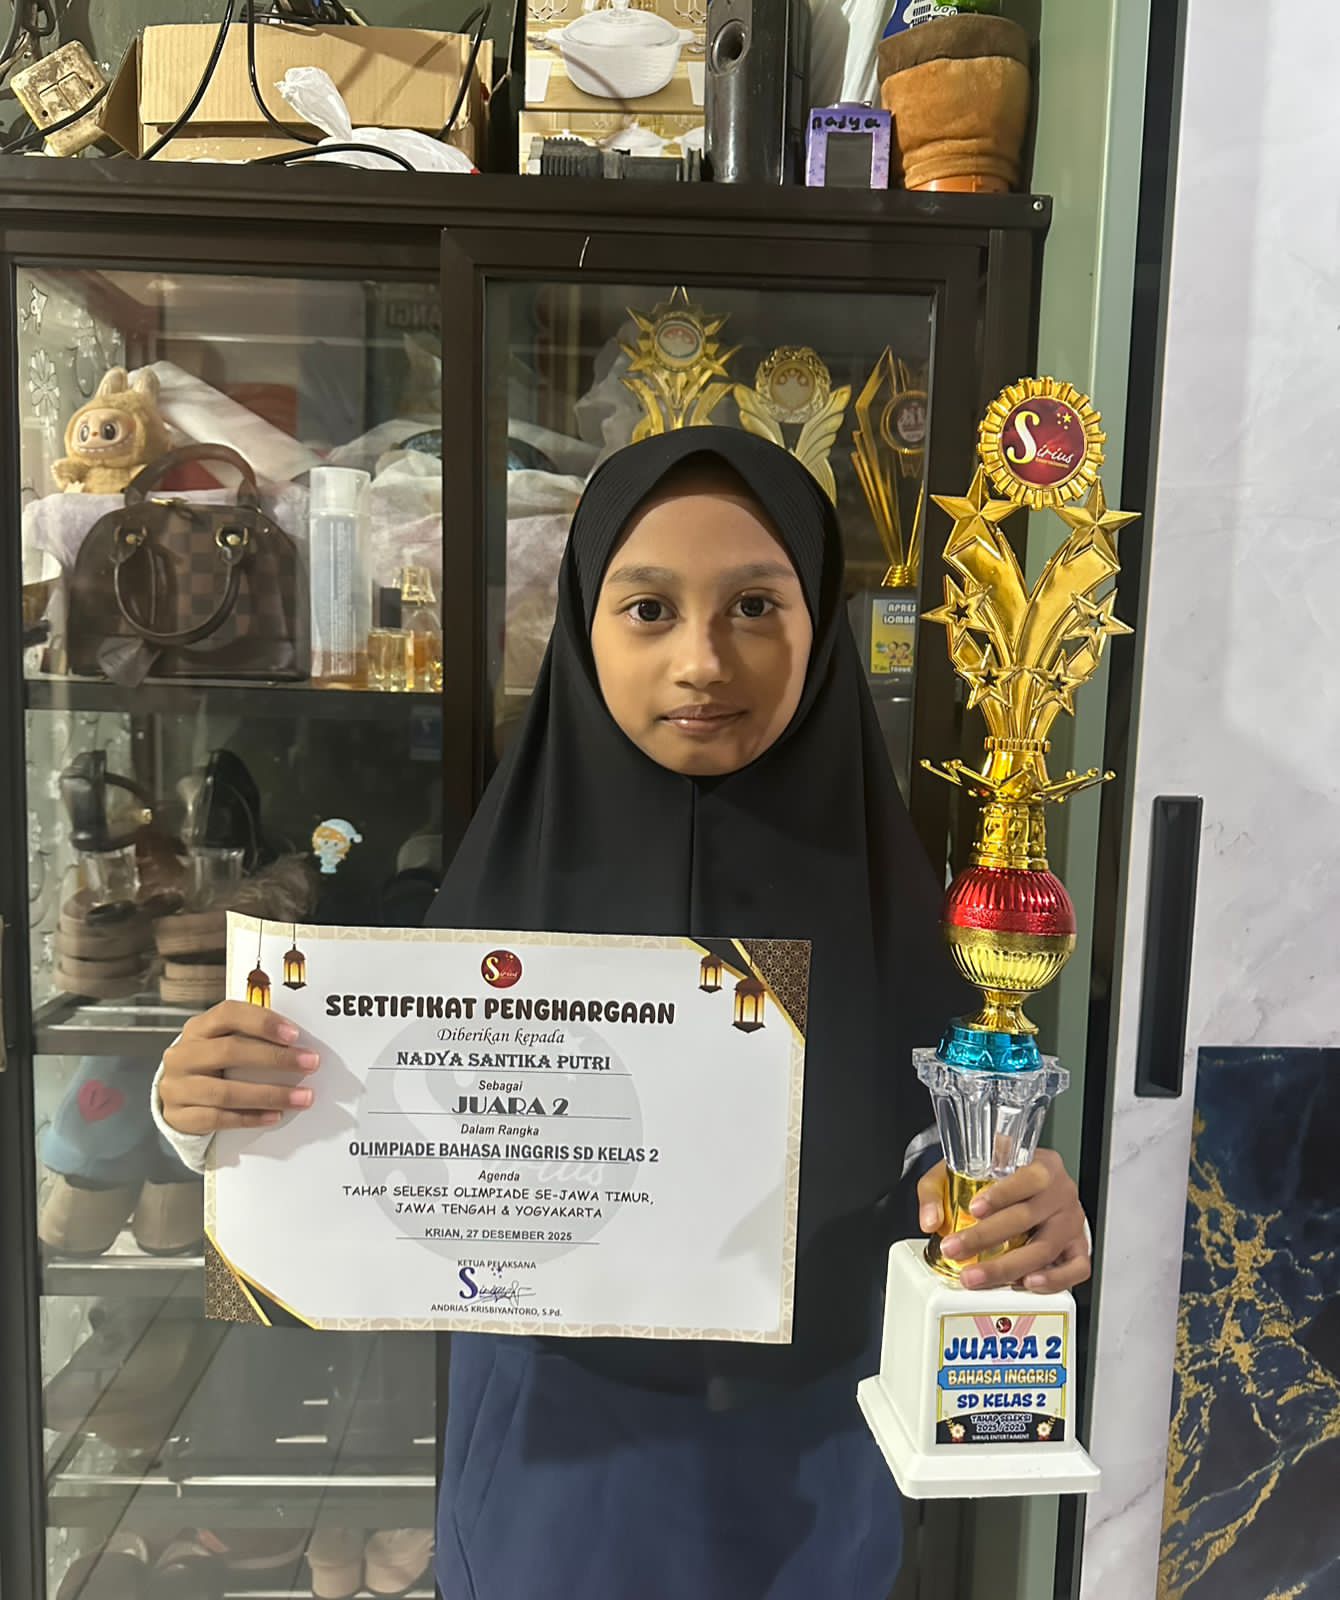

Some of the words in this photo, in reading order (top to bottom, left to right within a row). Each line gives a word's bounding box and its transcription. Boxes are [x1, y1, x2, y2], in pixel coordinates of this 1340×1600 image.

[812, 116, 881, 131] nadya
[1006, 410, 1074, 464] Sirius
[326, 994, 476, 1020] SERTIFIKAT
[485, 998, 675, 1025] PENGHARGAAN
[437, 1028, 510, 1046] Diberikan
[514, 1028, 565, 1047] kepada
[396, 1050, 463, 1067] NADYA
[468, 1053, 552, 1069] SANTIKA
[556, 1055, 611, 1071] PUTRI
[478, 1079, 523, 1094] Sebagai
[452, 1095, 546, 1116] JUARA
[552, 1098, 569, 1117] 2
[460, 1123, 495, 1136] Dalam
[498, 1125, 540, 1138] Rangka
[349, 1141, 436, 1158] OLIMPIADE
[439, 1143, 502, 1159] BAHASA
[505, 1144, 570, 1161] INGGRIS
[573, 1146, 594, 1161] SD
[597, 1147, 646, 1163] KELAS
[649, 1148, 659, 1163] 2
[478, 1170, 521, 1184] Agenda
[343, 1185, 389, 1198] TAHAP
[393, 1186, 449, 1199] SELEKSI
[453, 1187, 530, 1200] OLIMPIADE
[535, 1189, 600, 1202] SE-JAWA
[605, 1191, 654, 1205] TIMUR,
[395, 1203, 436, 1215] JAWA
[442, 1203, 497, 1216] TENGAH
[501, 1205, 510, 1217] &
[514, 1205, 603, 1219] YOGYAKARTA
[425, 1228, 463, 1239] KRIAN,
[466, 1228, 479, 1239] 27
[482, 1230, 545, 1241] DESEMBER
[547, 1231, 572, 1241] 2025
[458, 1259, 486, 1268] KETUA
[487, 1260, 537, 1270] PELAKSANA
[430, 1303, 469, 1313] ANDRIAS
[944, 1335, 1039, 1361] JUARA
[1045, 1335, 1062, 1360] 2
[948, 1369, 1001, 1387] BAHASA
[1004, 1367, 1058, 1385] INGGRIS
[957, 1393, 980, 1409] SD
[983, 1393, 1033, 1408] KELAS
[1036, 1393, 1047, 1408] 2
[970, 1414, 999, 1424] TAHAP
[999, 1413, 1032, 1423] SELEKSI
